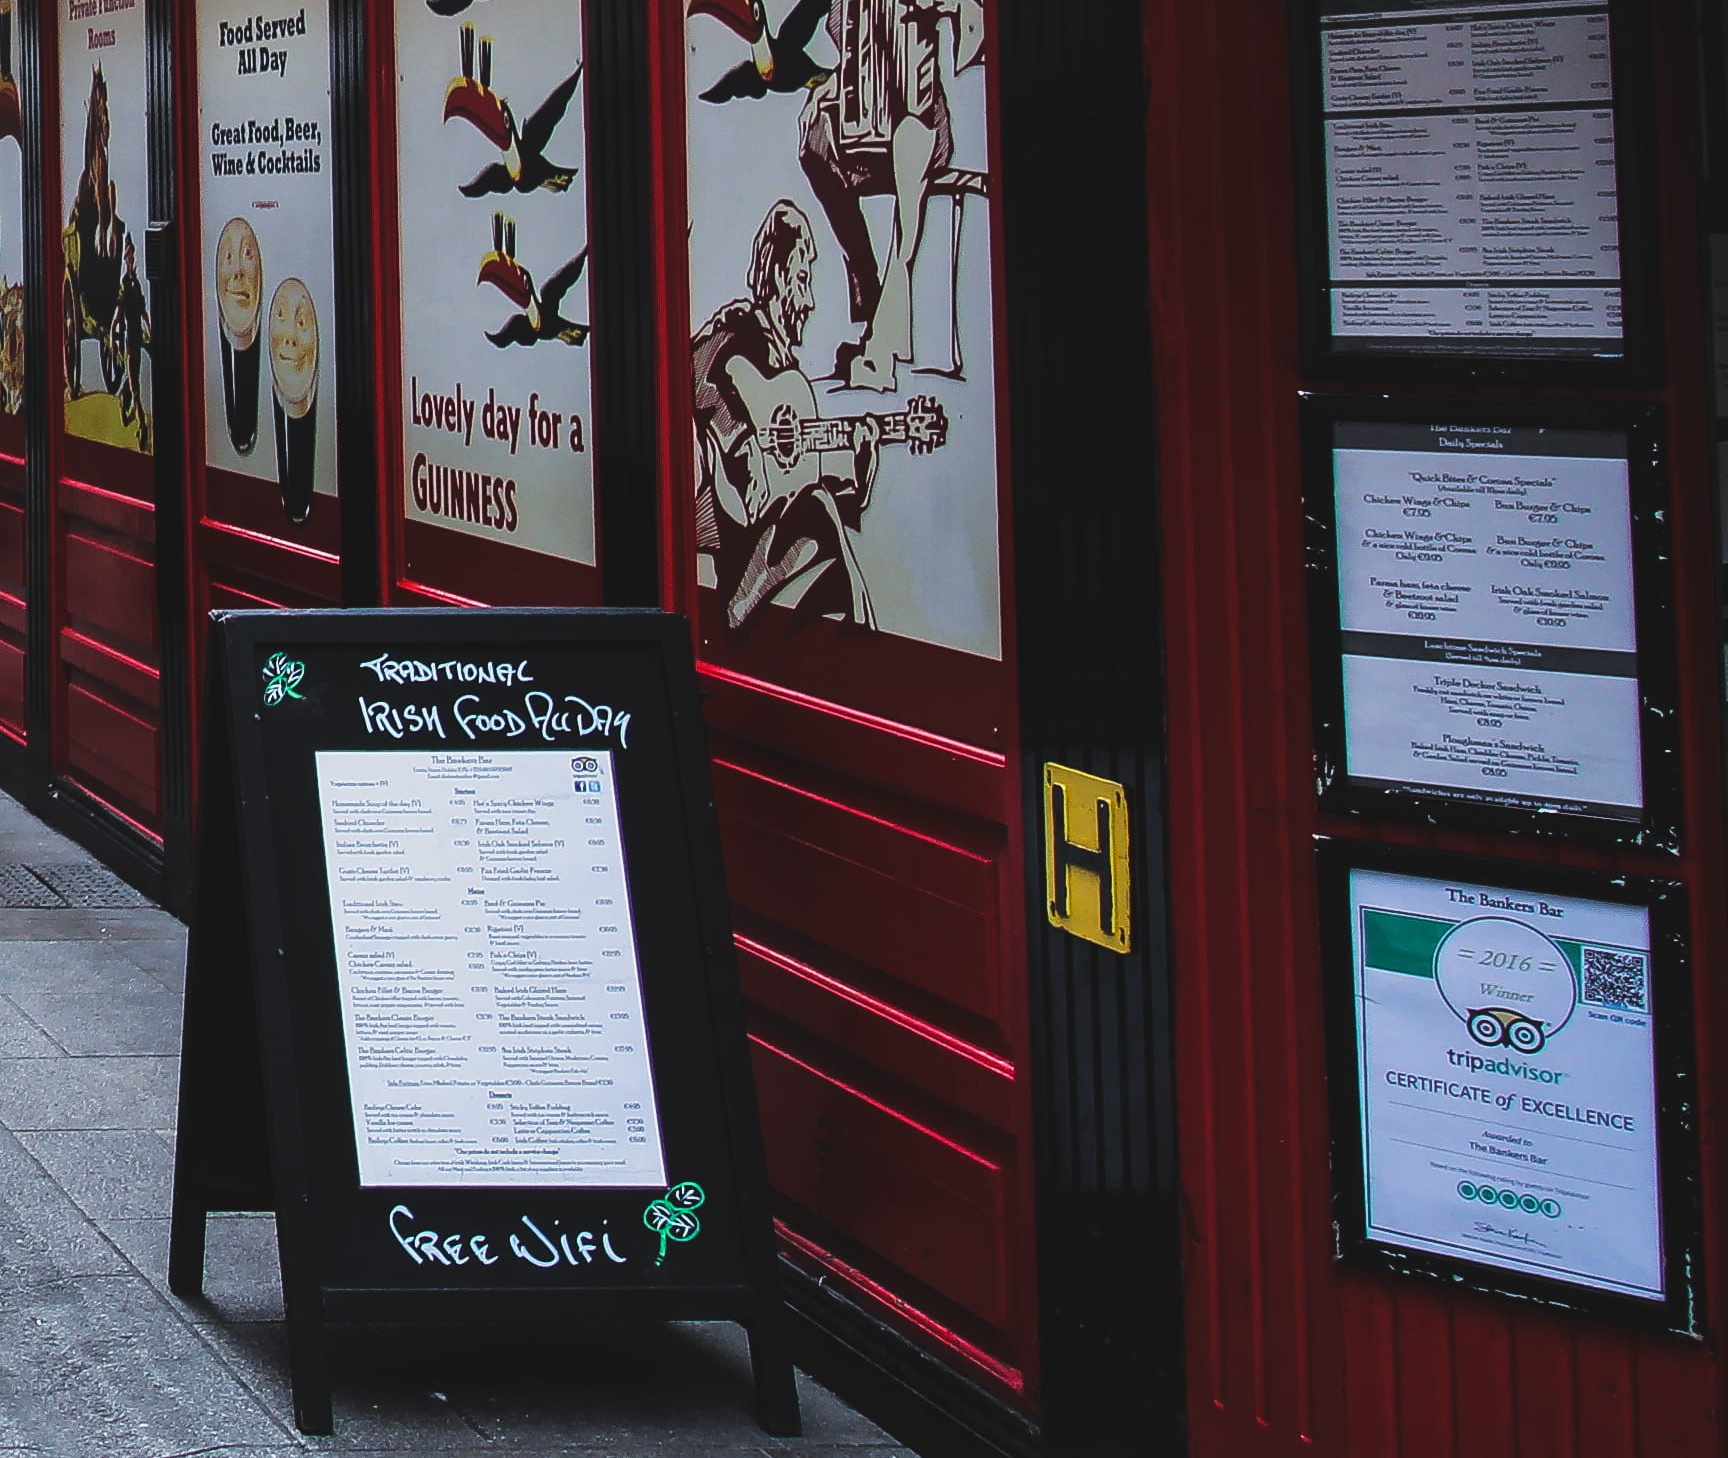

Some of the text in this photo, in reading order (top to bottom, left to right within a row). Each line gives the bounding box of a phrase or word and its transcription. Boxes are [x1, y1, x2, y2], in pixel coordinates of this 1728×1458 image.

[87, 27, 117, 50] Rooms
[218, 7, 307, 47] Food Served
[237, 45, 289, 78] All Day
[211, 116, 323, 148] Great Food, Beer,
[211, 147, 322, 177] Wine & Cocktails
[410, 375, 586, 456] Lovely day for a
[411, 451, 520, 534] GUINNESS
[360, 651, 535, 687] TRADITIONAL
[359, 694, 447, 739] IRISH
[1051, 781, 1116, 938] H
[1445, 888, 1565, 919] The Bankers Bar
[1477, 949, 1534, 973] 2016
[1479, 982, 1536, 1004] Winner
[1446, 1047, 1563, 1085] tripadvisor
[1385, 1070, 1636, 1133] CERTIFICATE of EXCELLENCE
[1468, 1141, 1549, 1166] The Bankers Bar
[388, 1204, 501, 1266] FREE
